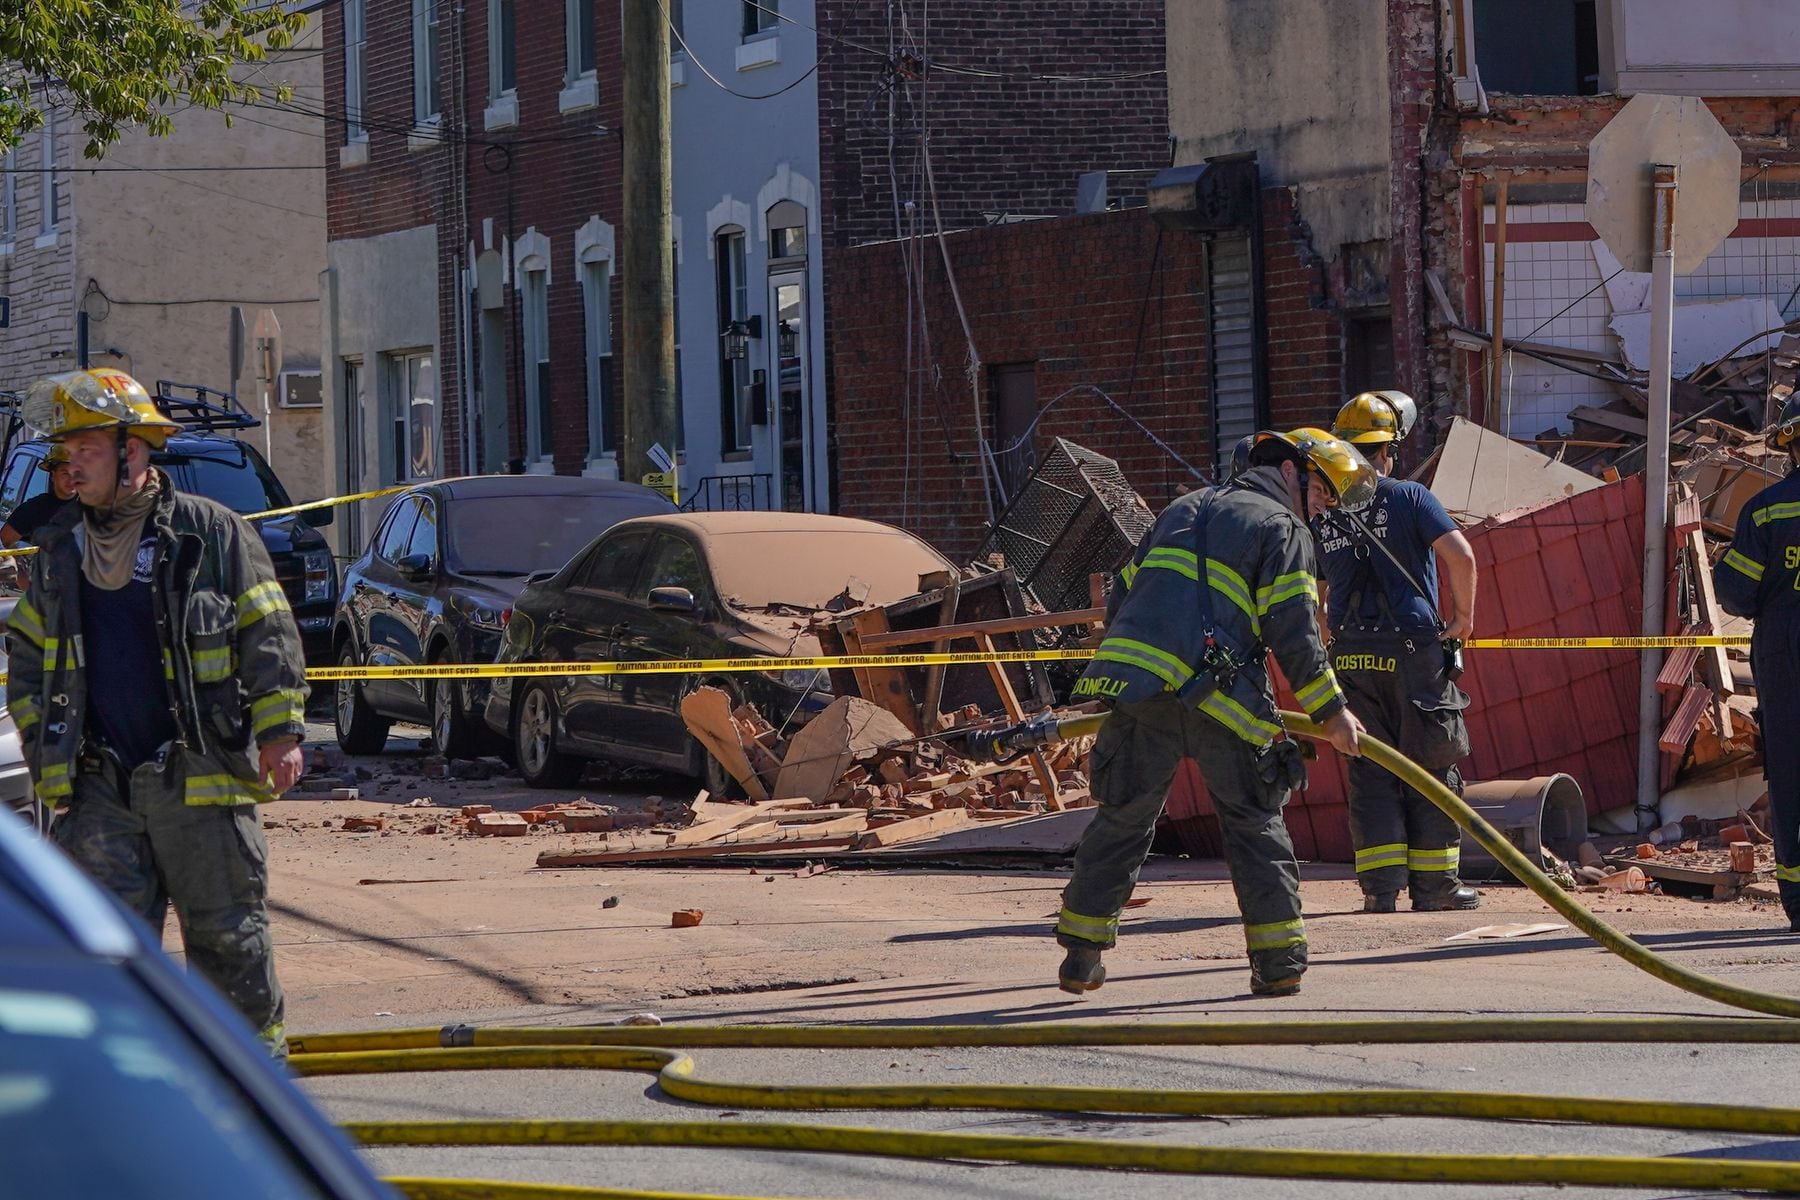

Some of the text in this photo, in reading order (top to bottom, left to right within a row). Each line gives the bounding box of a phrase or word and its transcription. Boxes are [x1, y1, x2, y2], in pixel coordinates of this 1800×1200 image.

[1502, 638, 1587, 647] CAUTION-DO NOT ENTER
[1612, 637, 1697, 646] CAUTION-DO NOT ENTER
[1721, 636, 1751, 645] CAUTION
[1060, 650, 1095, 658] CAUTION-
[1335, 654, 1397, 673] COSTELLO
